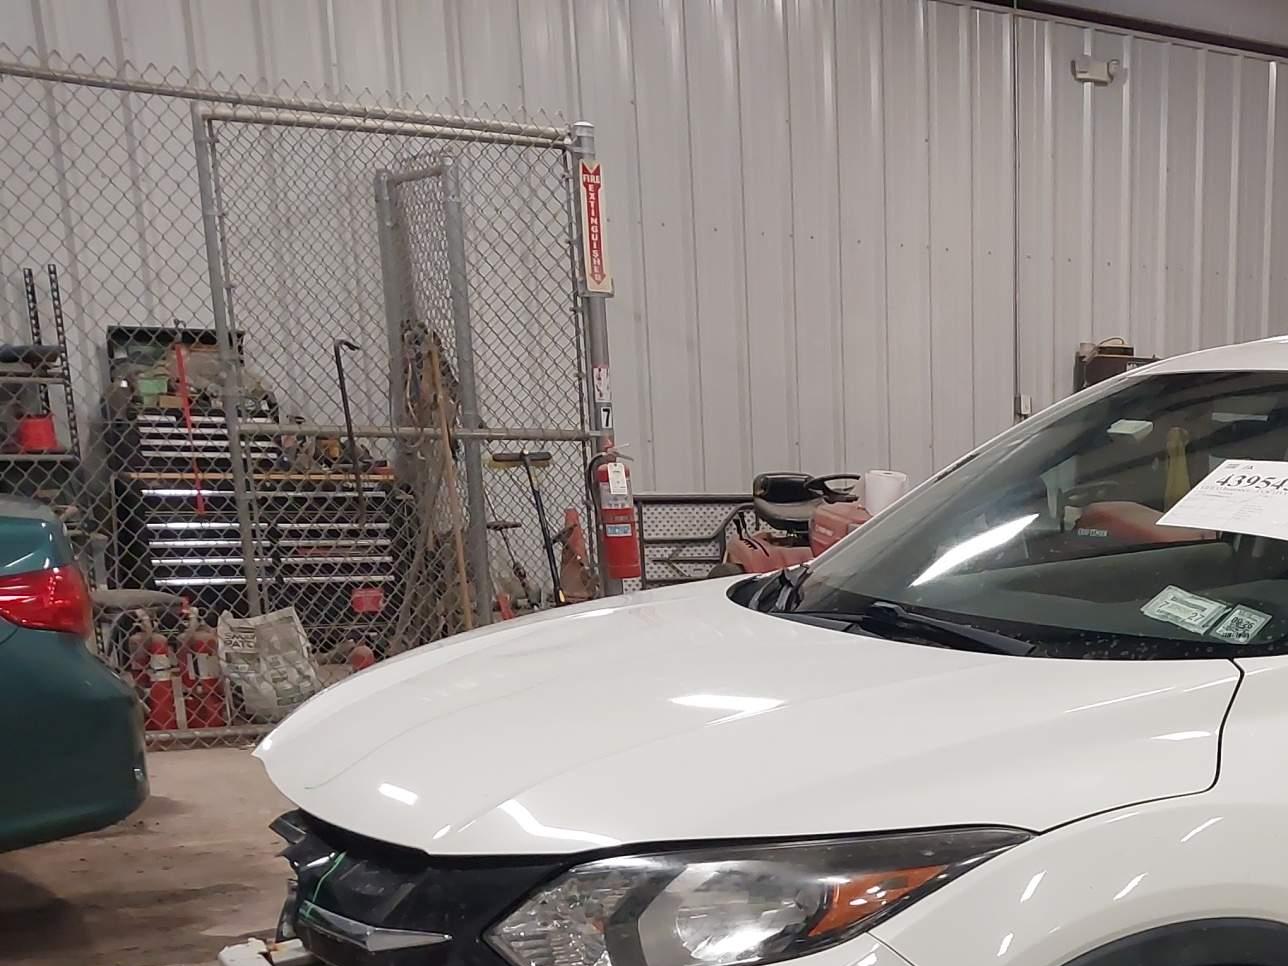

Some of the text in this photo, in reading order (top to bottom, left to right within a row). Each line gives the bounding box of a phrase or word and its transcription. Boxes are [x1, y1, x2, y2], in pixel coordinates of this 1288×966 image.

[583, 174, 600, 184] FIRE
[588, 184, 602, 282] EXTINGUISHER
[602, 408, 610, 427] 7
